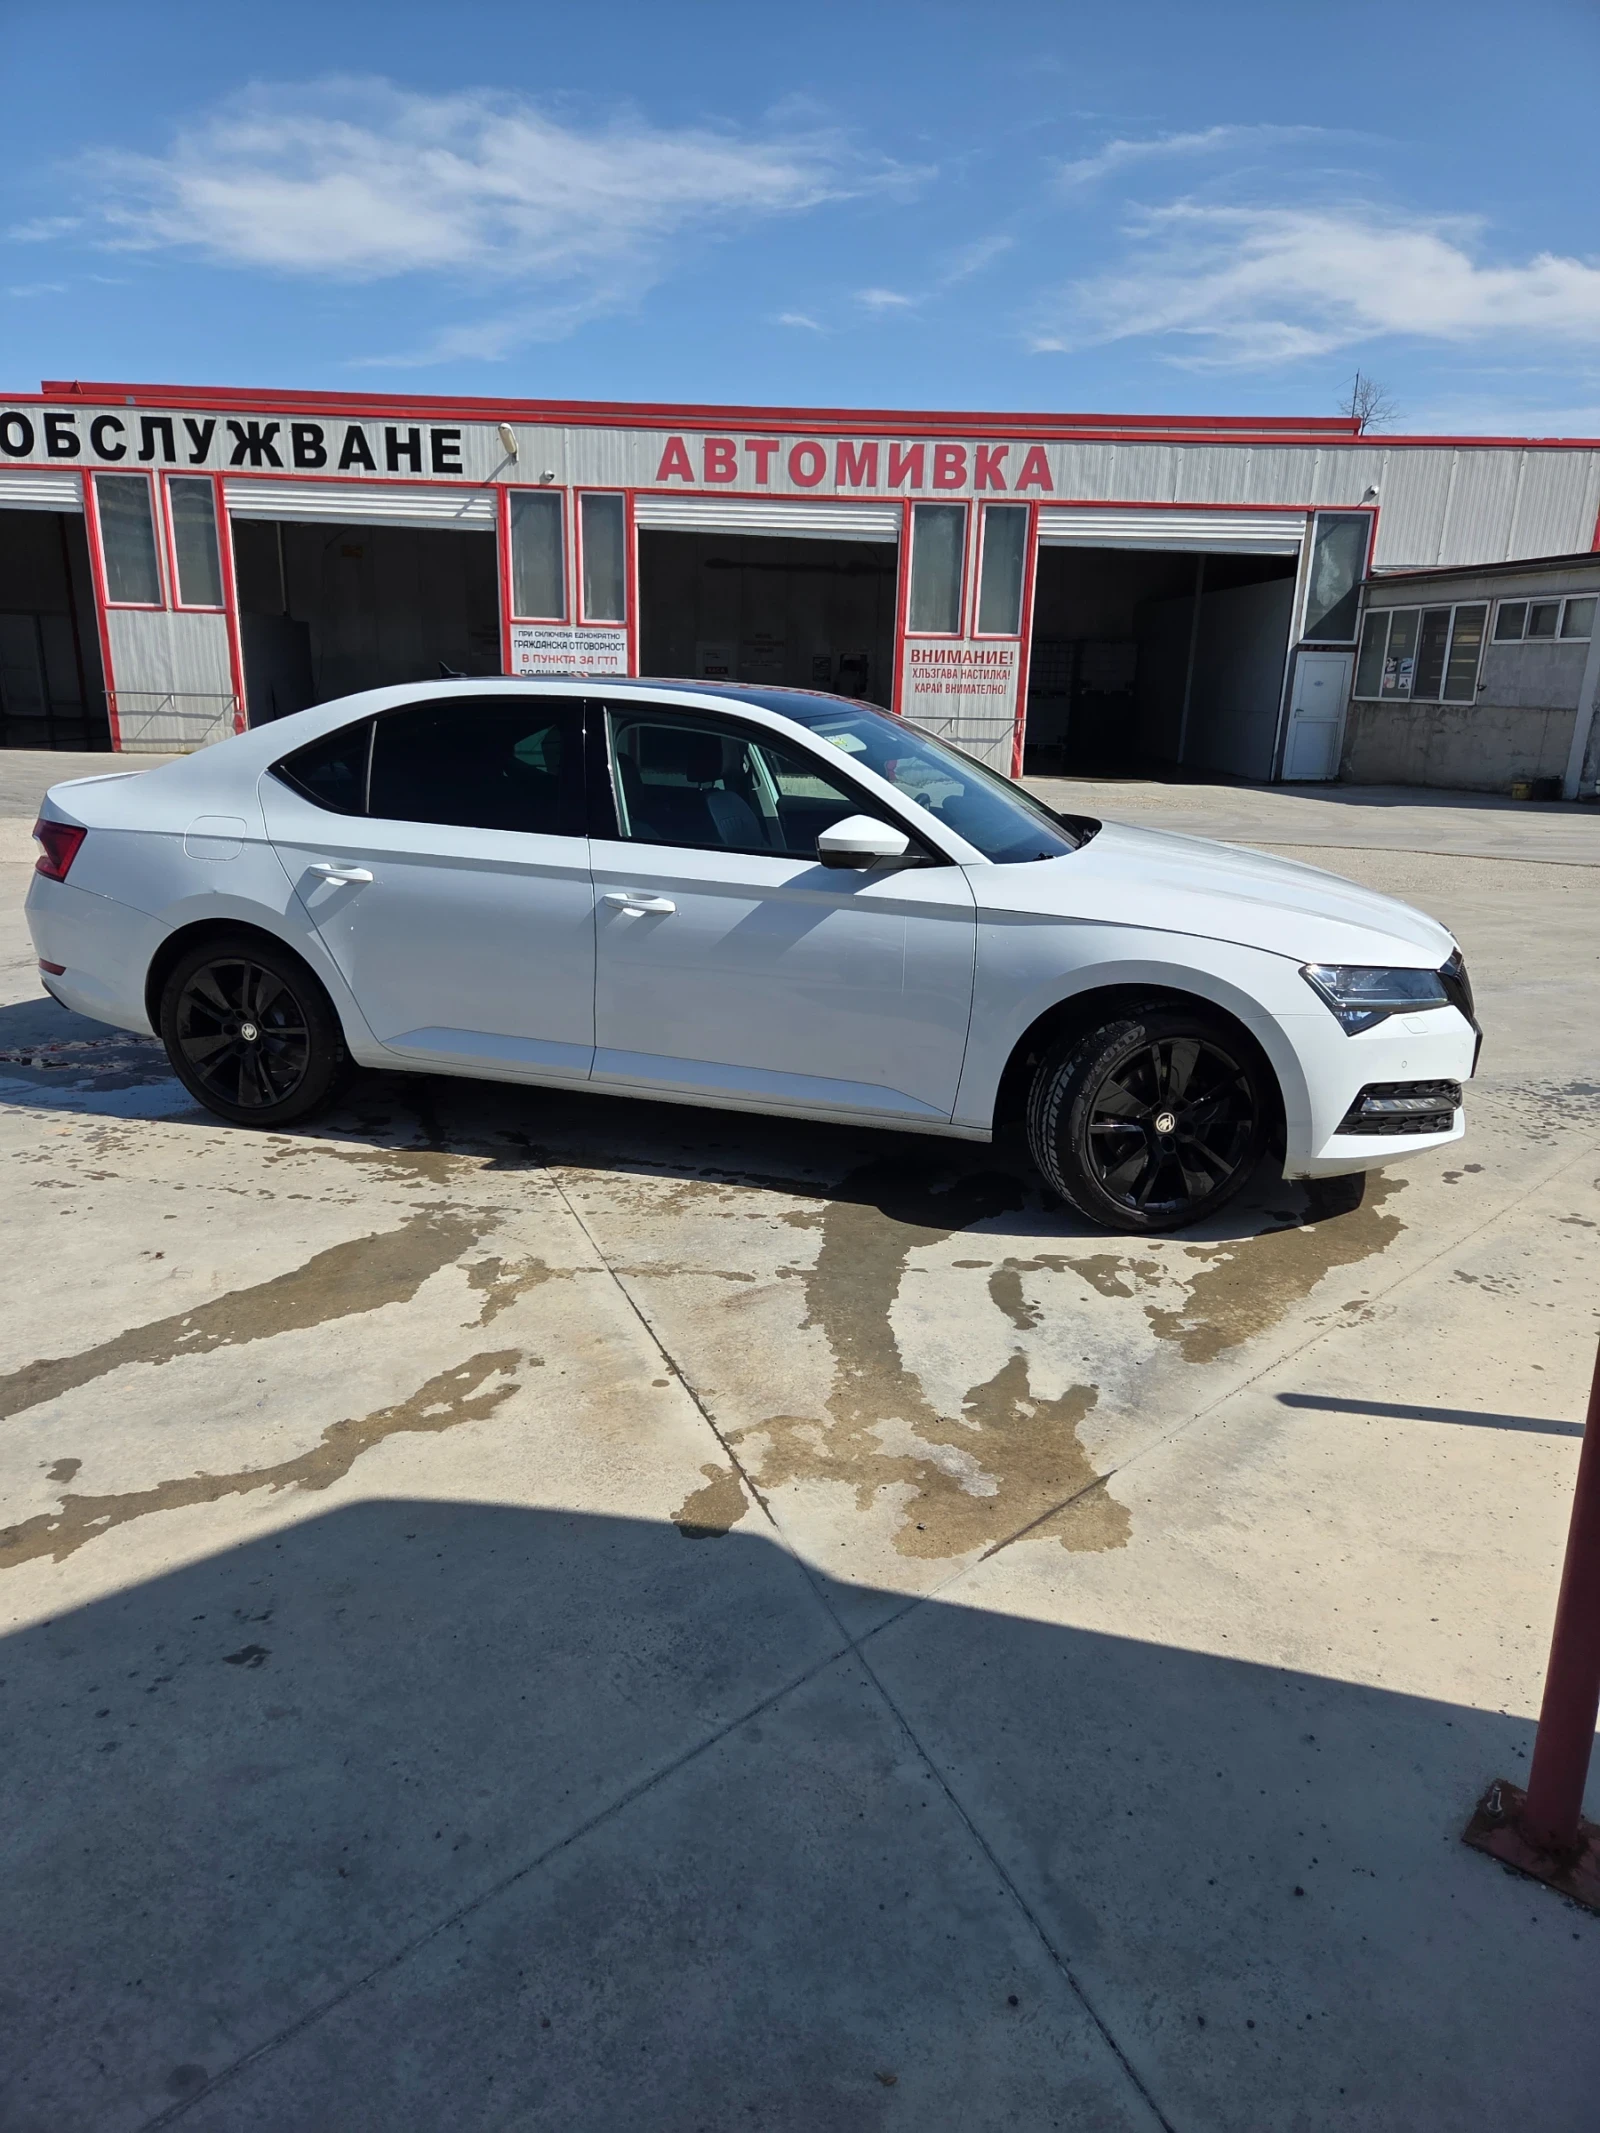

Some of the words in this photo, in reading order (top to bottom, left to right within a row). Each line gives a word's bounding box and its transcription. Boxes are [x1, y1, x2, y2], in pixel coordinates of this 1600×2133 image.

[0, 410, 464, 474] ОБСЛУЖВАНЕ
[655, 436, 1054, 492] АВТОМИВКА
[518, 630, 533, 638] ПРИ
[534, 630, 573, 639] СКЛЮЧЕНА
[574, 632, 621, 640] ЕДНОКРАТНО
[514, 640, 568, 650] ГРАЖДАНСКА
[569, 641, 626, 652] ОТГОВОРНОСТ
[522, 653, 530, 663] В
[533, 654, 576, 665] ПУНКТА
[579, 655, 594, 665] ЗА
[597, 656, 618, 666] ГТП
[910, 649, 1014, 665] ВНИМАНИЕ!
[912, 668, 958, 680] ХЛЪЗГАВА
[961, 669, 1011, 681] НАСТИЛКА!
[915, 681, 943, 694] КАРАЙ
[945, 683, 1007, 695] ВНИМАТЕЛНО!
